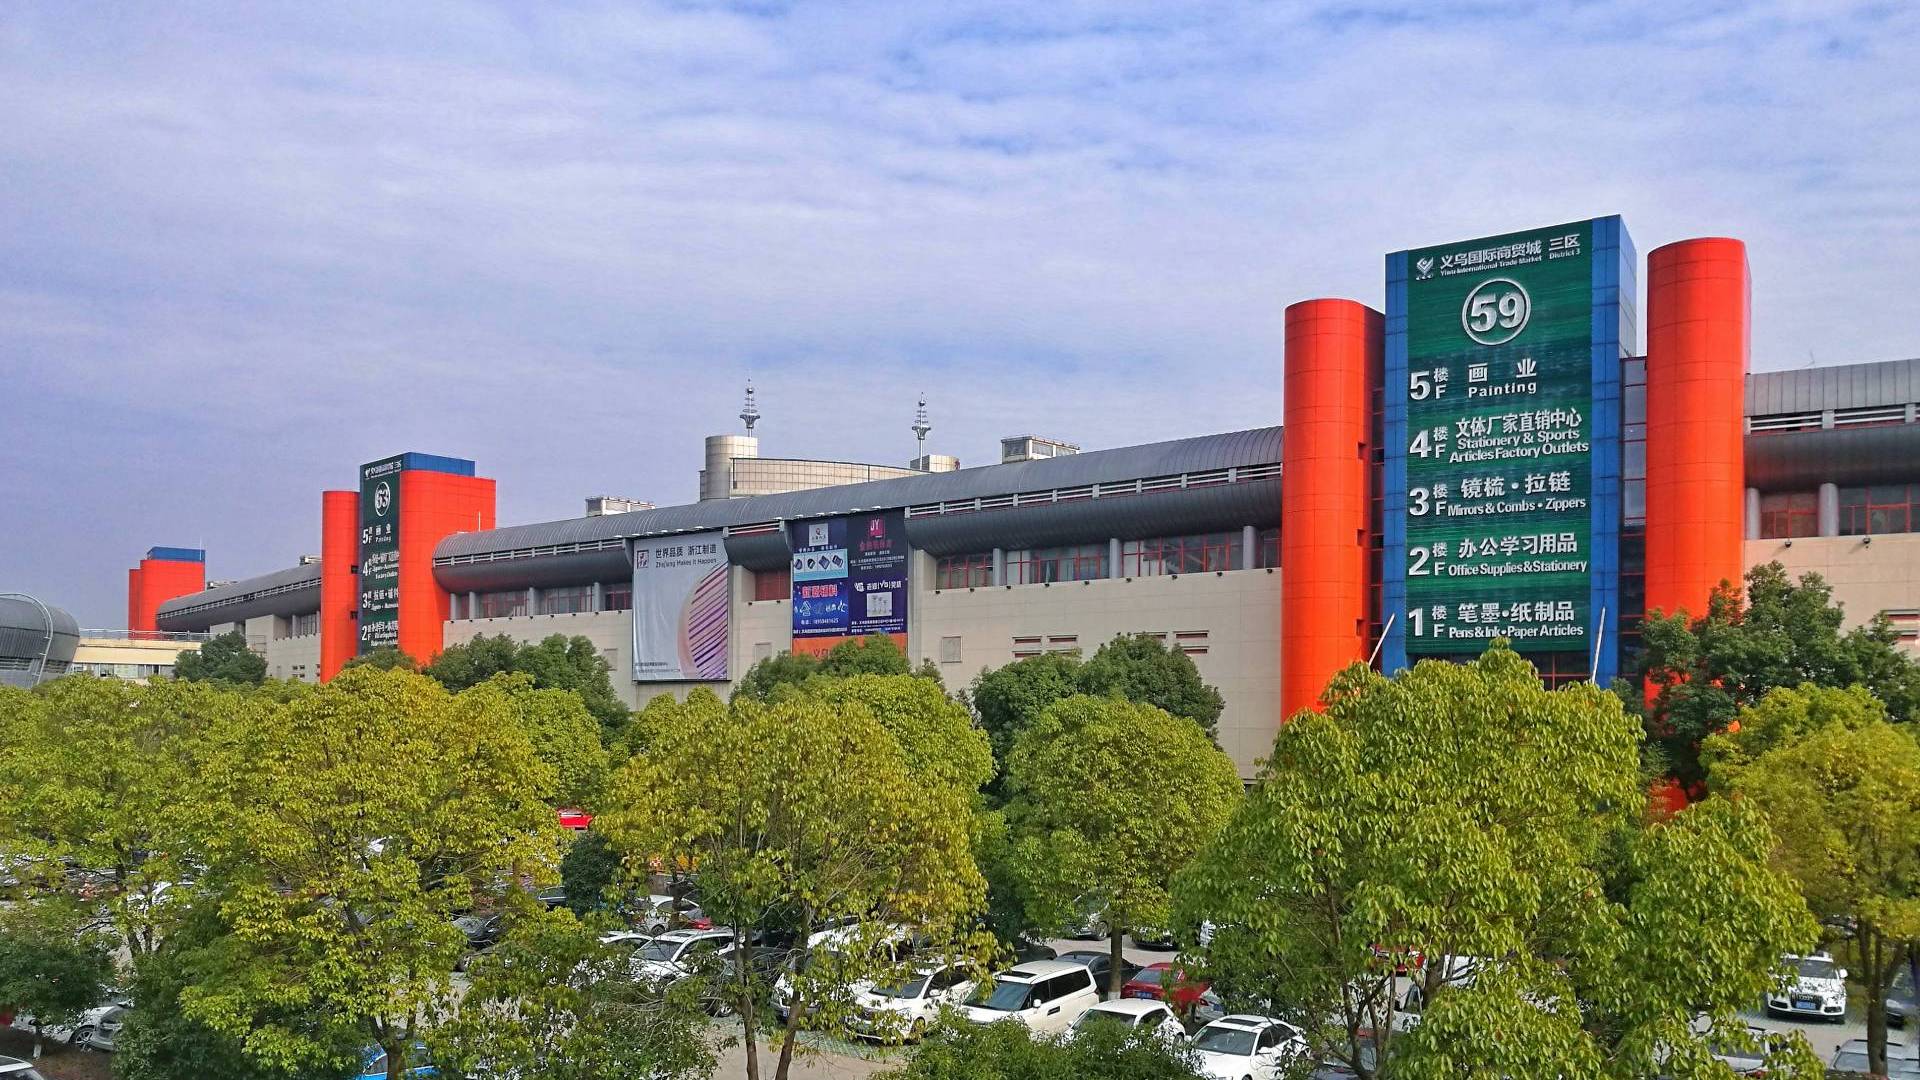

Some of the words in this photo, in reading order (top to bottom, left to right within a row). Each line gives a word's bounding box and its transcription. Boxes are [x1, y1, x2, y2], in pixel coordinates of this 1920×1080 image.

[1440, 240, 1542, 269] 义乌国际商贸城
[1548, 233, 1580, 251] 三区
[1457, 262, 1498, 274] International
[1519, 255, 1542, 264] Market
[1549, 249, 1575, 259] District
[1470, 291, 1525, 332] 59
[1433, 367, 1449, 382] 楼
[1410, 371, 1431, 400] 5
[1435, 384, 1447, 399] F
[1468, 382, 1537, 398] Painting
[1456, 408, 1582, 438] 文体厂家直销中心
[1433, 426, 1448, 441] 楼
[1457, 434, 1520, 450] Stationery
[1523, 432, 1534, 444] &
[1537, 429, 1580, 443] Sports
[1409, 429, 1431, 458] 4
[1435, 443, 1446, 458] F
[1449, 450, 1494, 463] Articles
[1495, 446, 1541, 458] Factory
[1542, 441, 1589, 455] Outlets
[1433, 483, 1448, 499] 楼
[1409, 487, 1430, 516] 3
[1435, 501, 1447, 516] F
[1447, 504, 1484, 517] Mirrors
[1485, 503, 1495, 515] &
[1496, 500, 1536, 513] Combs
[1545, 498, 1586, 511] Zippers
[362, 528, 369, 545] 5
[655, 546, 683, 559] 世界品质
[1432, 542, 1447, 557] 楼
[1458, 533, 1578, 558] 办公学习用品
[362, 561, 369, 577] 4
[1408, 546, 1430, 576] 2
[1434, 562, 1446, 576] F
[1448, 563, 1479, 576] Office
[1480, 561, 1522, 577] Supplies
[362, 592, 368, 608] 3
[1432, 605, 1447, 620] 楼
[1408, 608, 1424, 637] 1
[361, 625, 368, 641] 2
[1433, 624, 1445, 638] F
[1507, 625, 1538, 639] Paper
[1539, 623, 1584, 636] Articles
